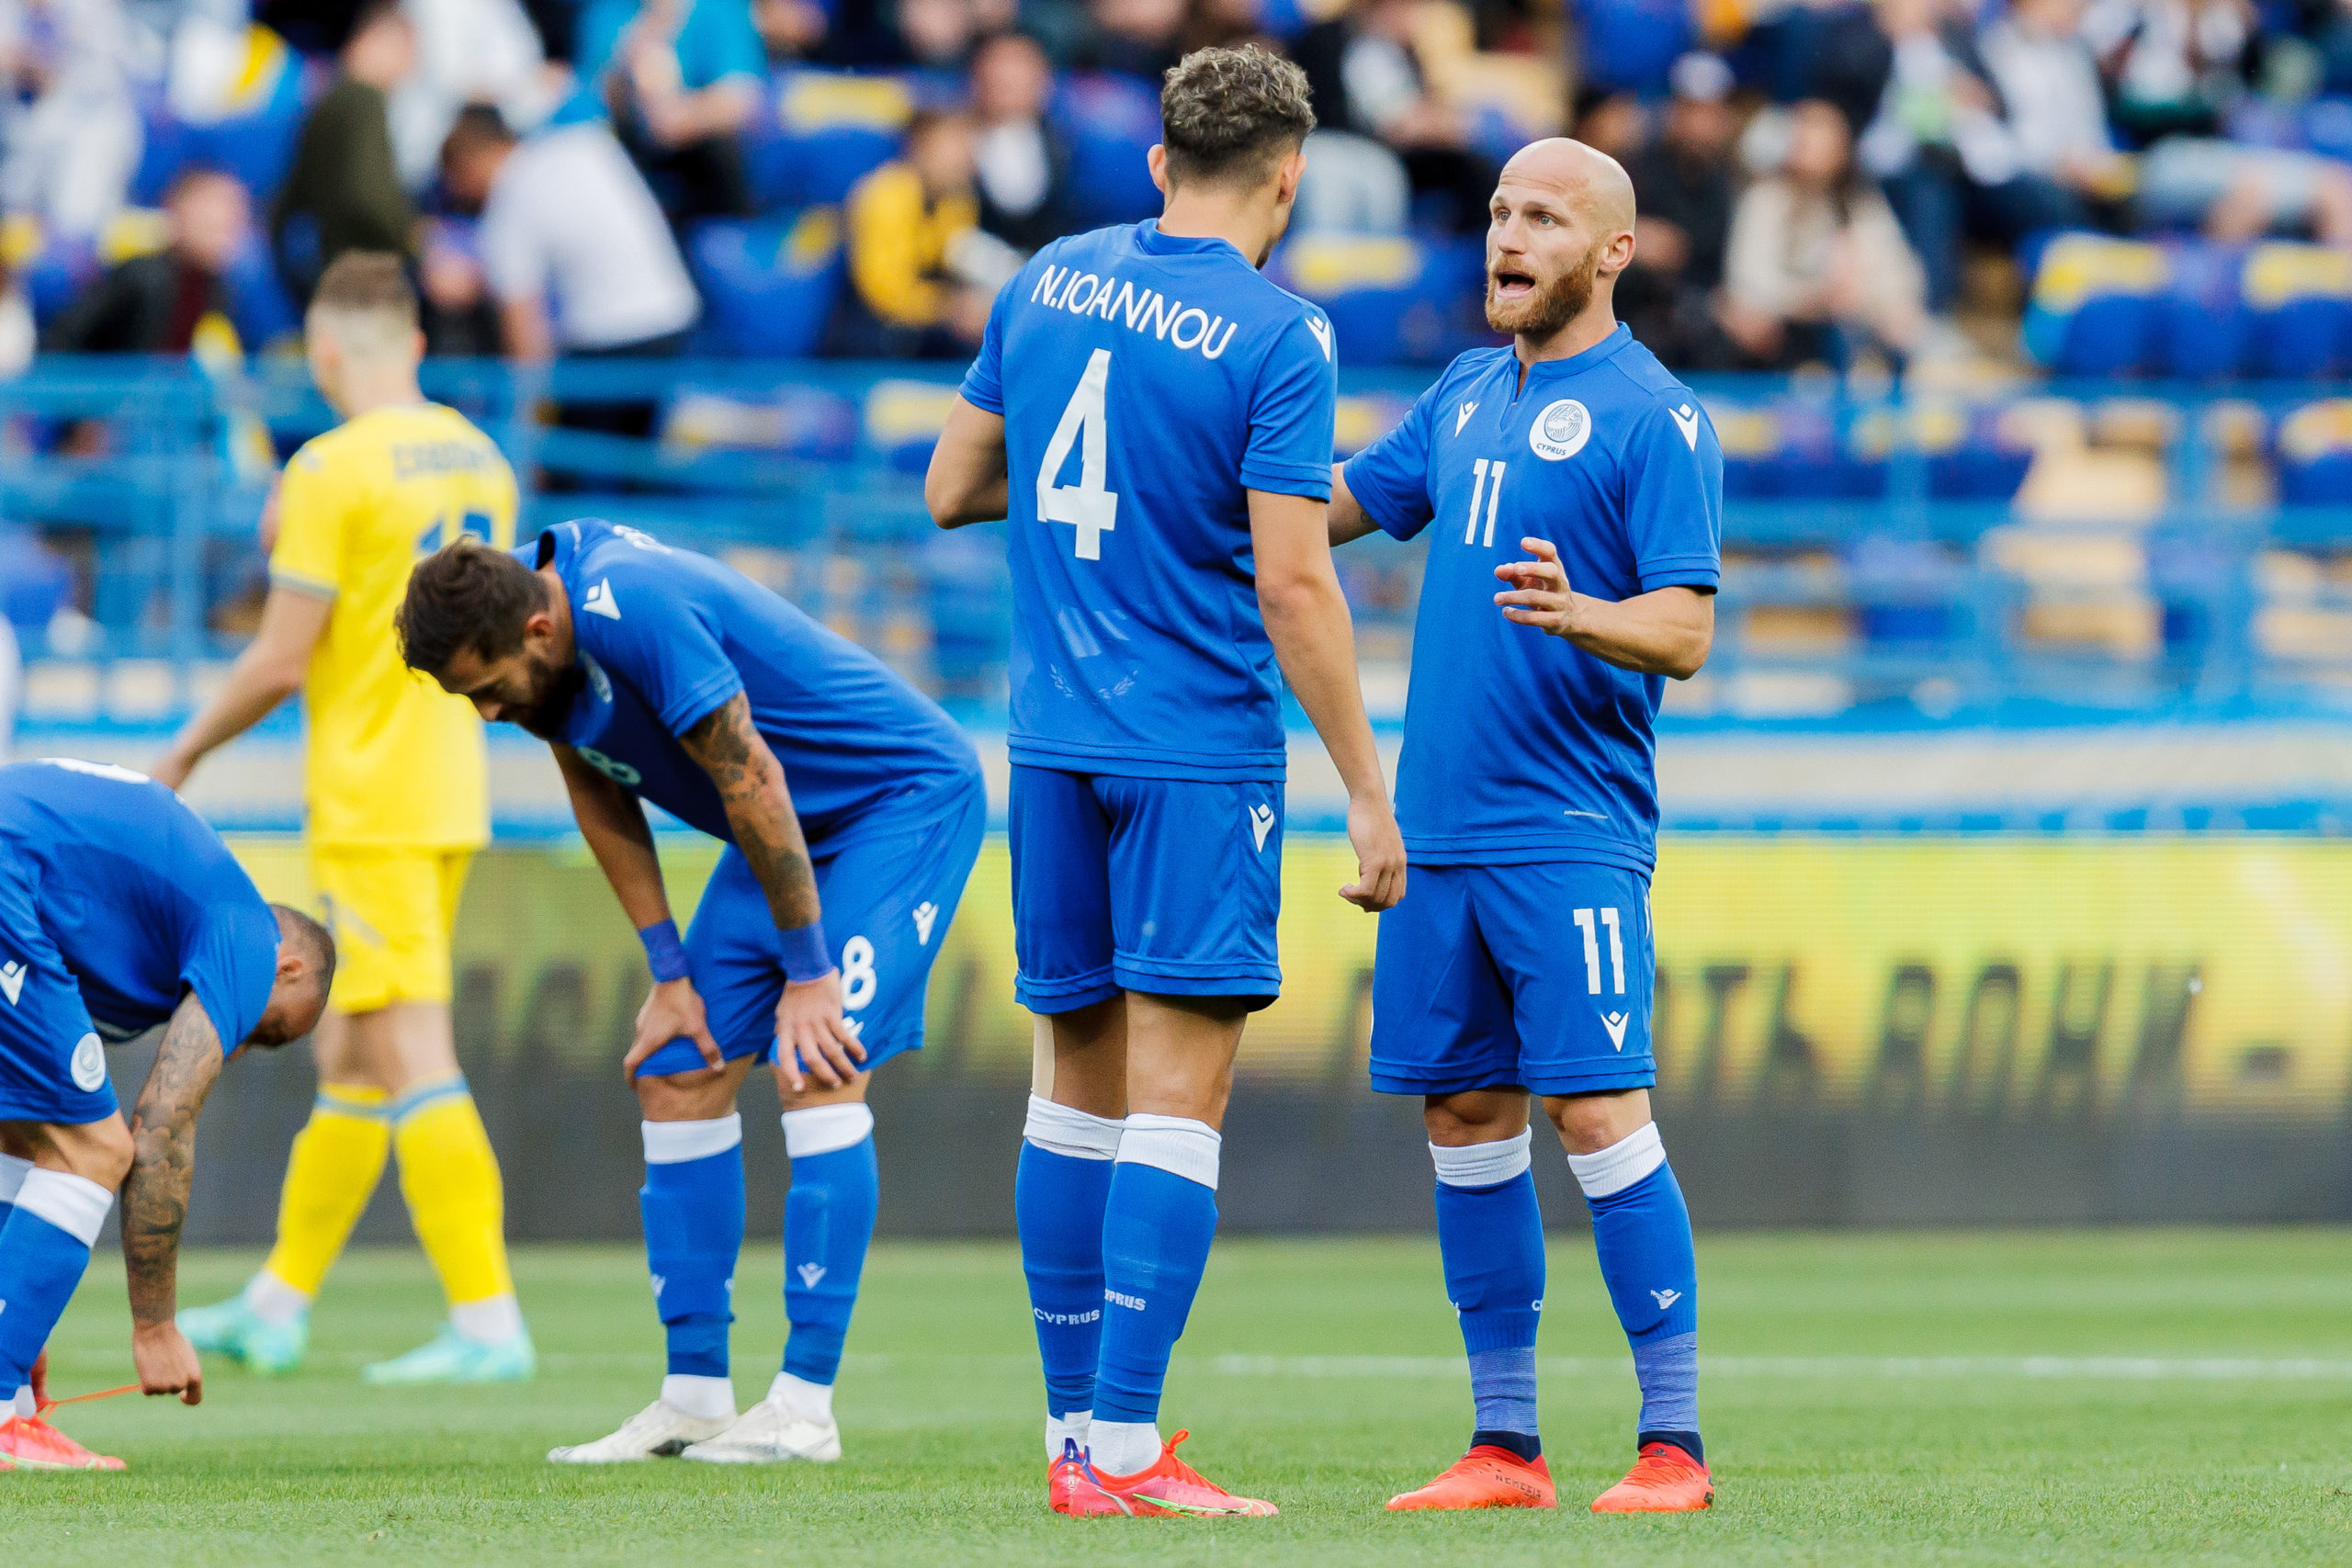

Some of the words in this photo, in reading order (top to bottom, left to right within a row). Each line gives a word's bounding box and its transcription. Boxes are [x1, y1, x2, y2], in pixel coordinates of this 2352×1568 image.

[1031, 264, 1238, 360] N.IOANNOU
[1036, 347, 1118, 561] 4
[1536, 443, 1566, 456] CYPRUS
[1464, 457, 1507, 547] 11
[841, 934, 877, 1011] 8
[1573, 907, 1625, 995] 11
[1033, 1307, 1101, 1325] CYPRUS
[1104, 1287, 1147, 1312] YPRUS
